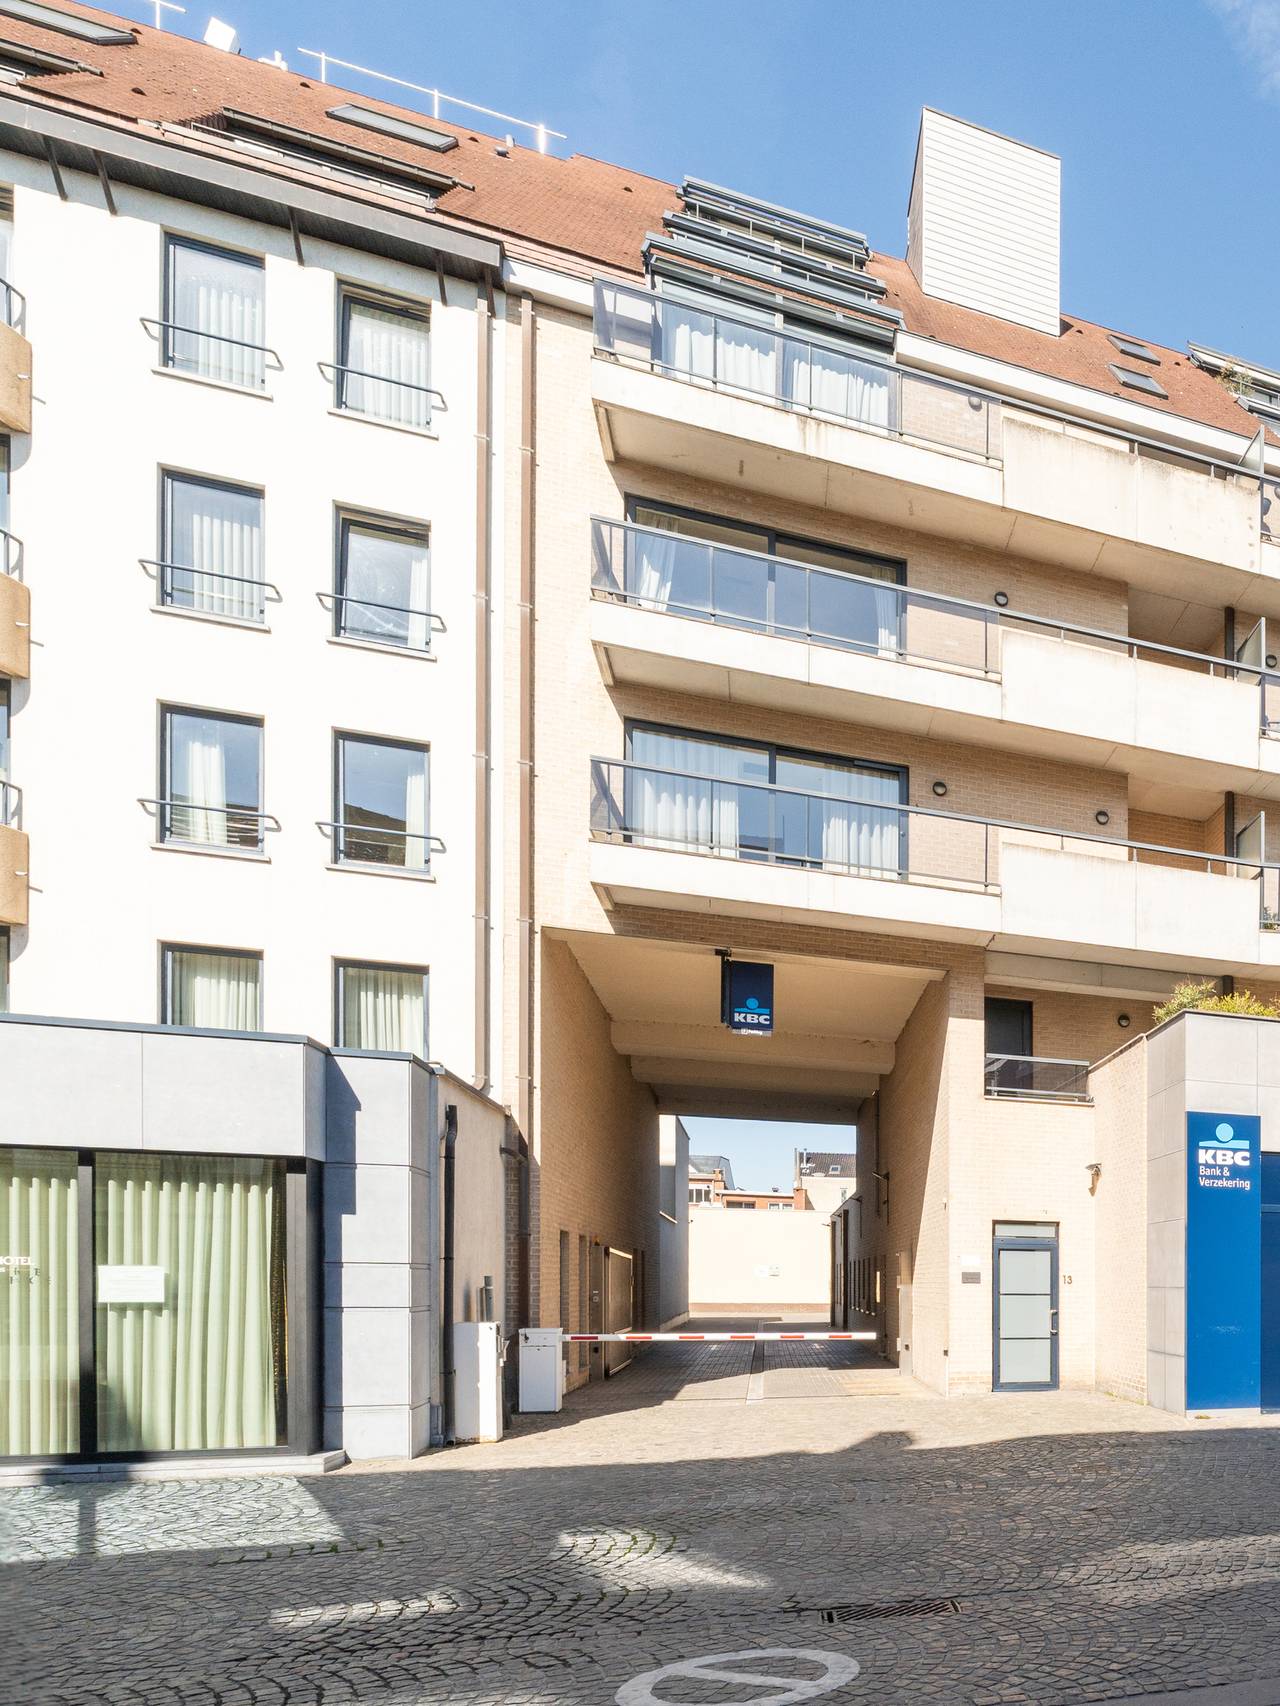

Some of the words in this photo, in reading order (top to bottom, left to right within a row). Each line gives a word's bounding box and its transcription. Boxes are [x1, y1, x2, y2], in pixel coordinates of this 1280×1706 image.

[733, 1012, 770, 1025] KBC
[1198, 1149, 1250, 1166] KBC
[1199, 1165, 1221, 1176] Bank
[1223, 1166, 1230, 1177] &
[1198, 1177, 1251, 1191] Verzekering
[1062, 1275, 1073, 1285] 13
